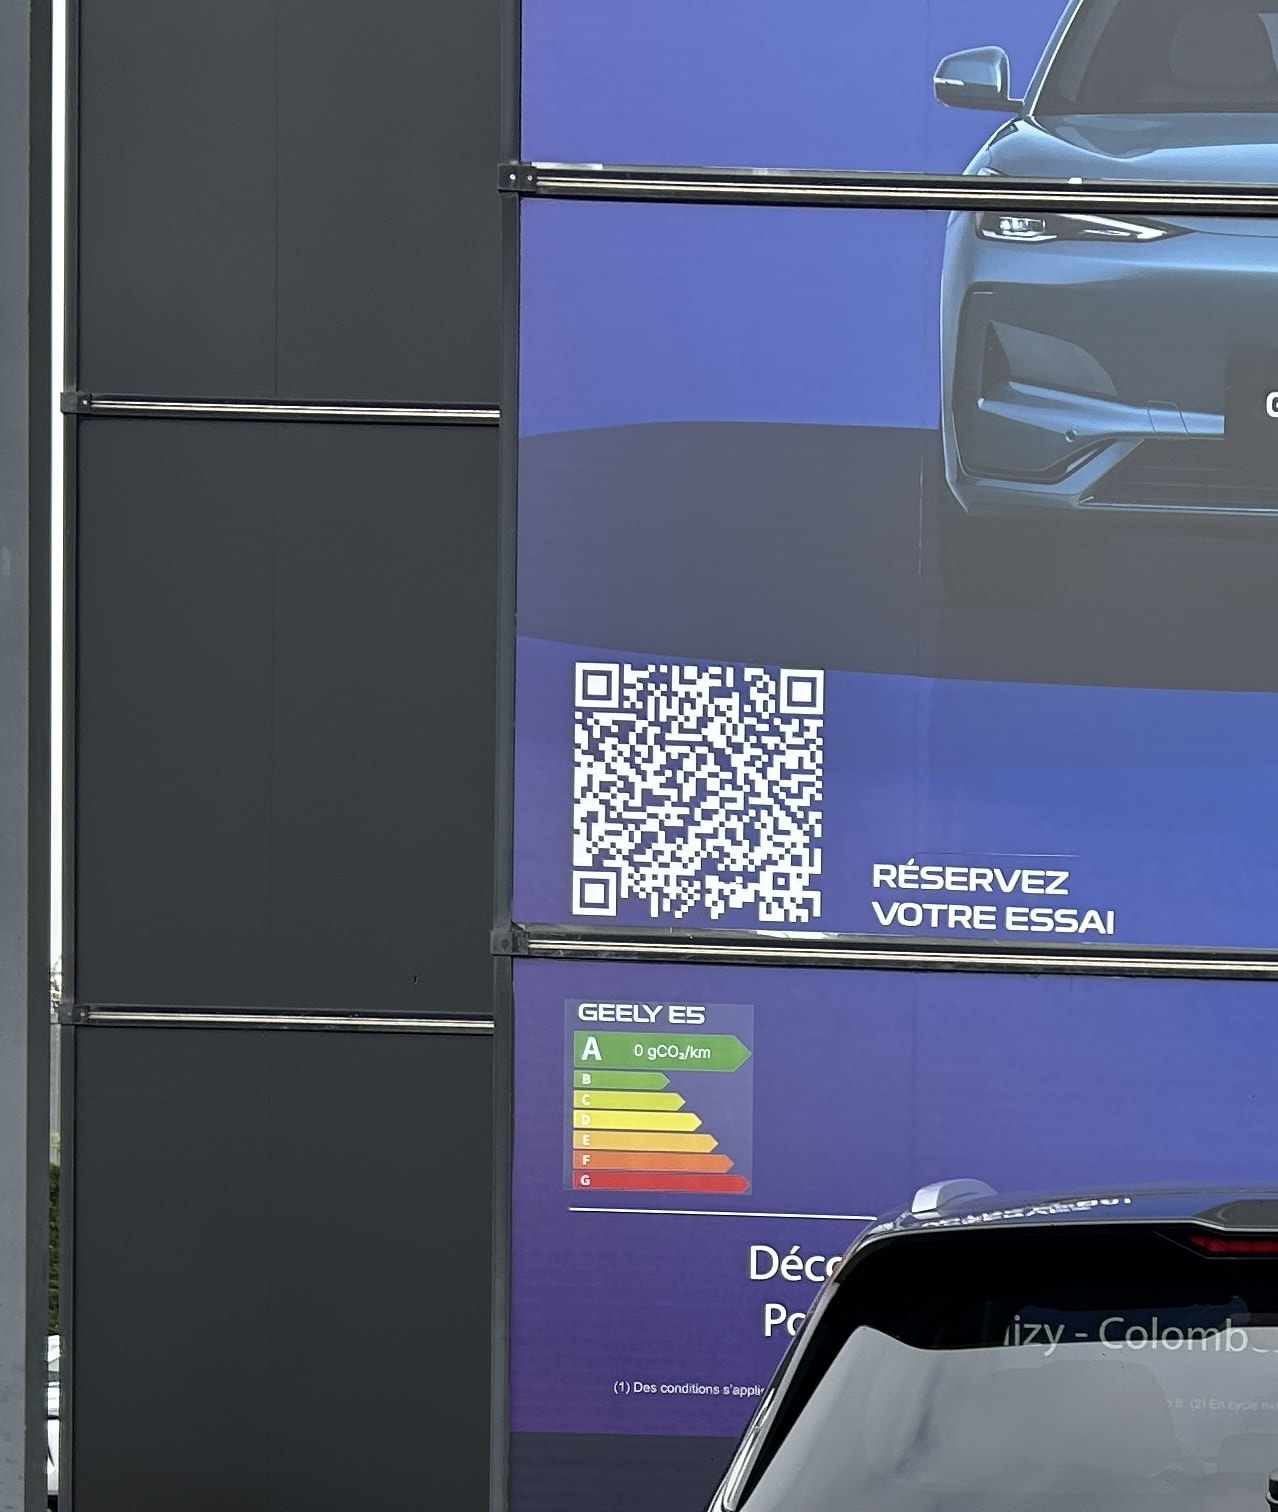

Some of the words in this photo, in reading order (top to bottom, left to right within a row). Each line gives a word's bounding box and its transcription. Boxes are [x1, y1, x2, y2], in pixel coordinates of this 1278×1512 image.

[872, 858, 1069, 896] RÉSERVEZ
[872, 901, 997, 930] VOTRE
[1004, 906, 1115, 935] ESSAI
[578, 1003, 663, 1023] GEELY
[669, 1005, 706, 1024] E5
[581, 1036, 602, 1061] A
[634, 1044, 643, 1057] 0
[582, 1074, 592, 1085] B
[582, 1094, 591, 1105] C
[582, 1134, 591, 1145] E
[582, 1155, 591, 1166] F
[580, 1175, 591, 1186] G
[614, 1381, 630, 1394] (1)
[633, 1381, 657, 1393] Des
[660, 1383, 719, 1395] conditions
